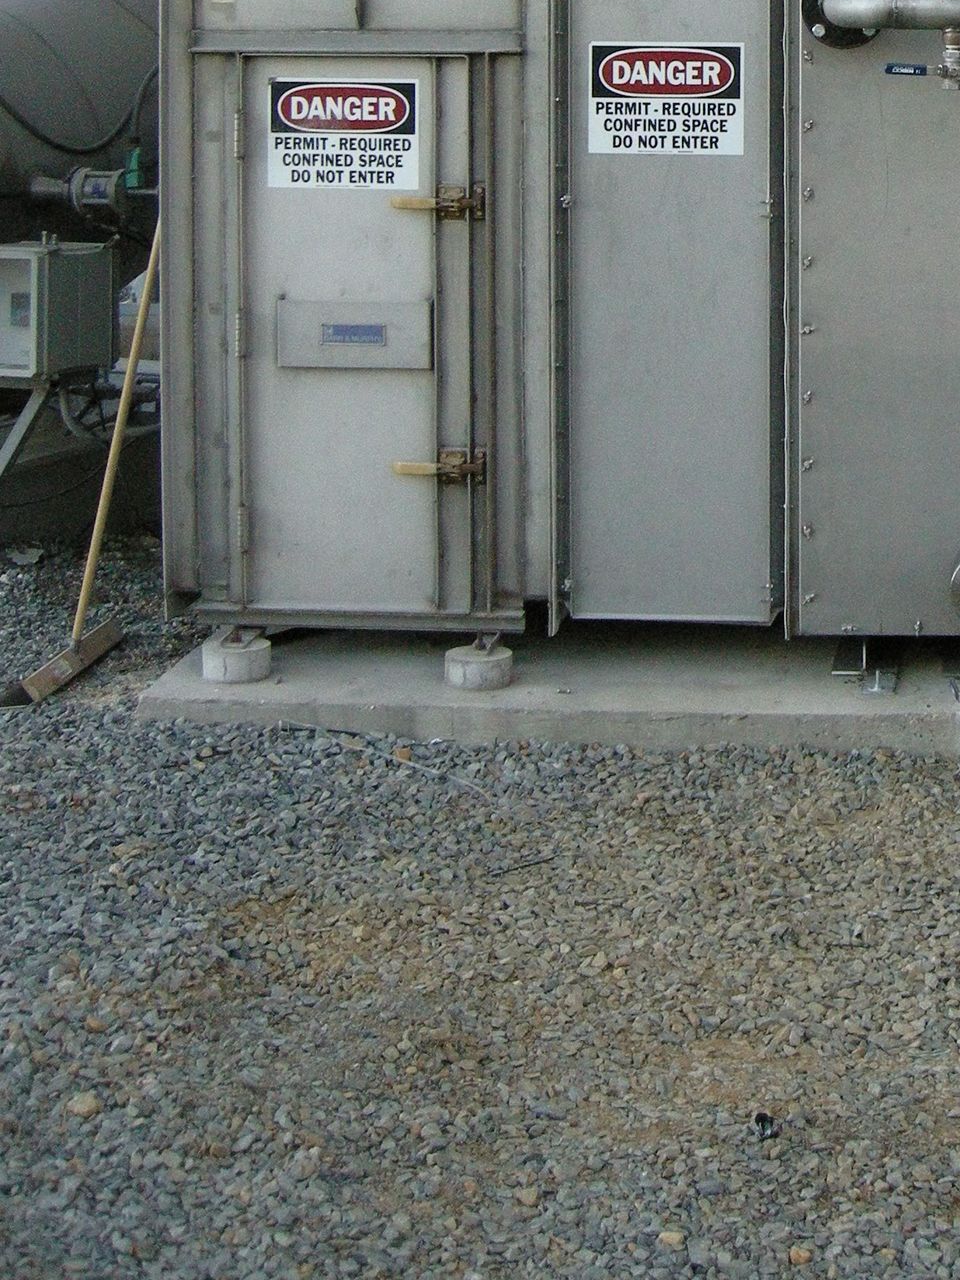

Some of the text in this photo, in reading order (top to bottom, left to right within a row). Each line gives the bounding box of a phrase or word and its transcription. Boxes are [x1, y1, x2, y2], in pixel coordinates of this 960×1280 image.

[612, 60, 721, 86] DANGER
[290, 96, 397, 121] DANGER
[596, 101, 651, 115] PERMIT
[662, 102, 736, 117] REQUIRED
[604, 118, 728, 133] CONFINED SPACE
[274, 137, 329, 150] PERMIT
[339, 137, 412, 152] REQUIRED
[612, 135, 719, 149] DO NOT ENTER
[282, 153, 403, 168] CONFINED SPACE
[291, 169, 395, 184] DO NOT ENTER
